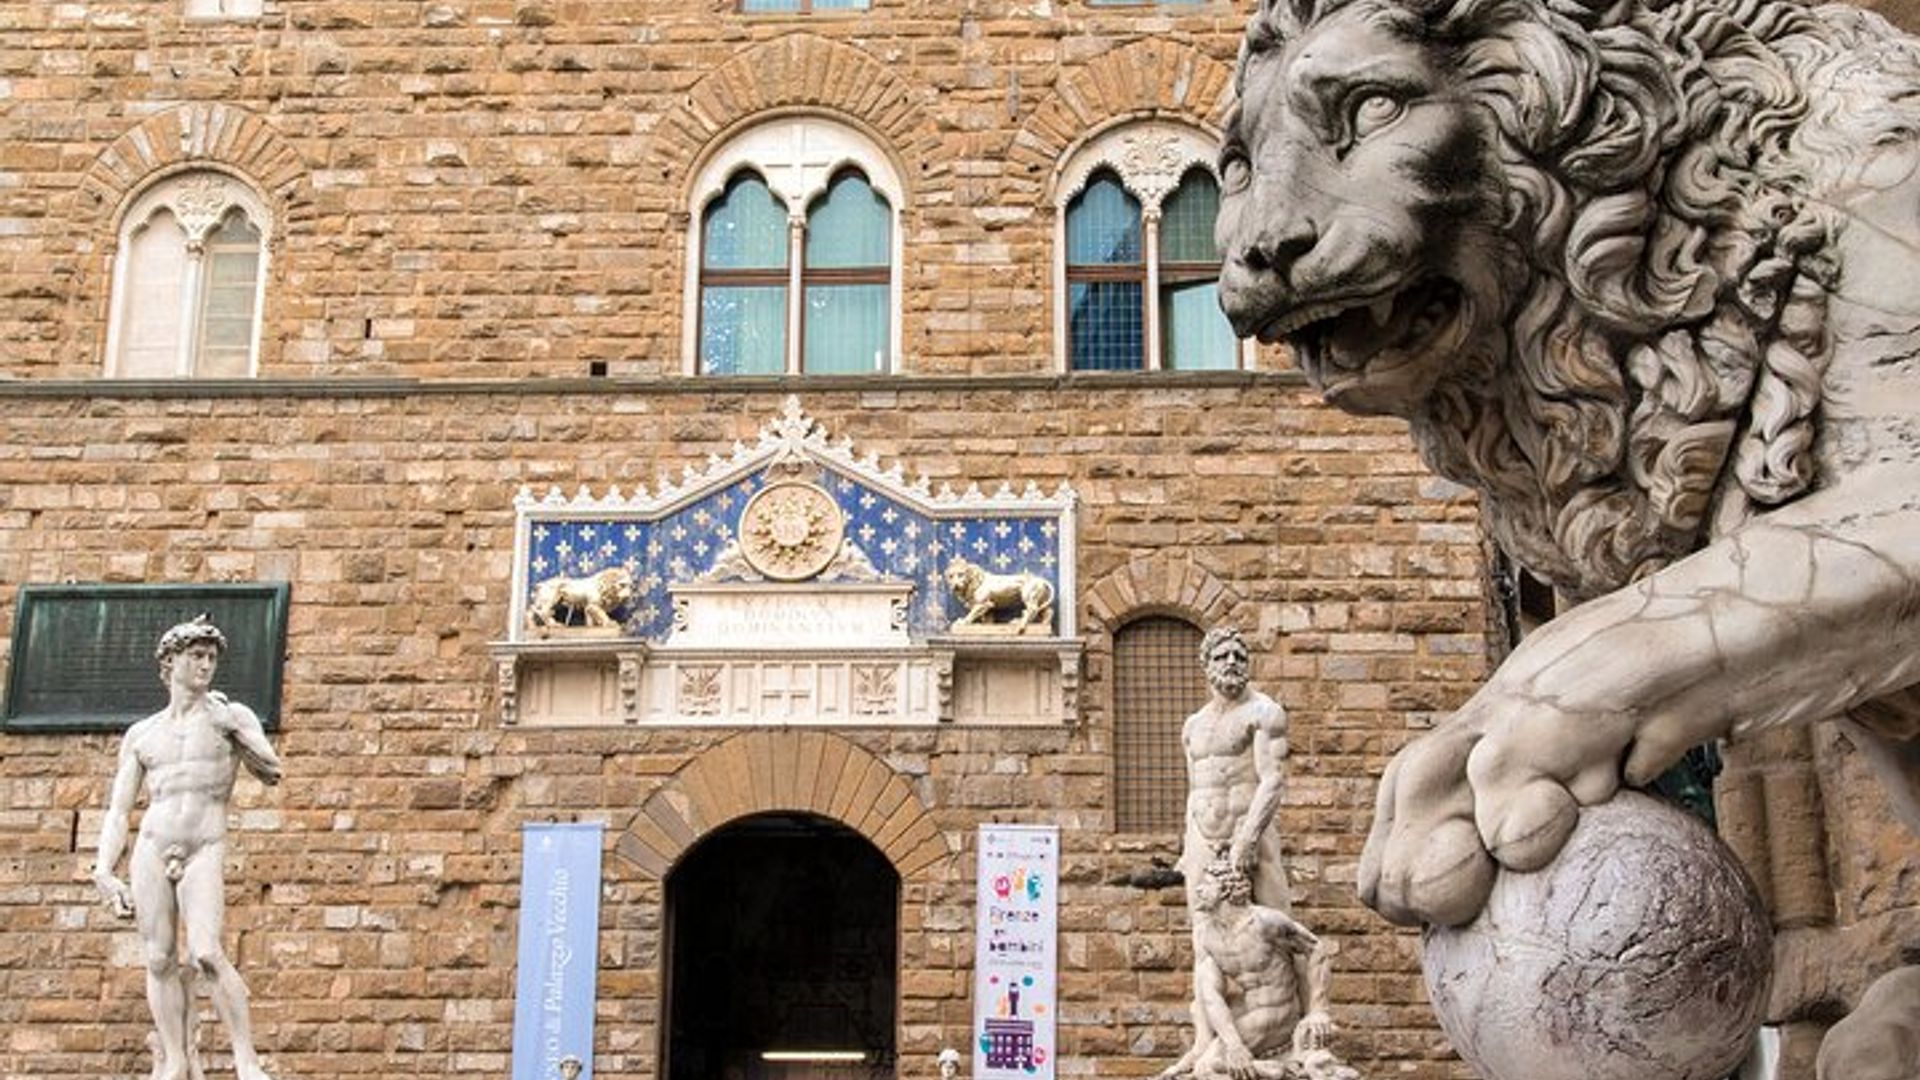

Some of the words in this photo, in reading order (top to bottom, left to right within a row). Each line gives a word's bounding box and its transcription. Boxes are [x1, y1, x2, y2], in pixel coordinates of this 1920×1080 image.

[547, 866, 569, 936] Vecchio
[990, 905, 1039, 922] Firenze
[989, 940, 1044, 953] bambini
[543, 938, 572, 1010] Palazzo
